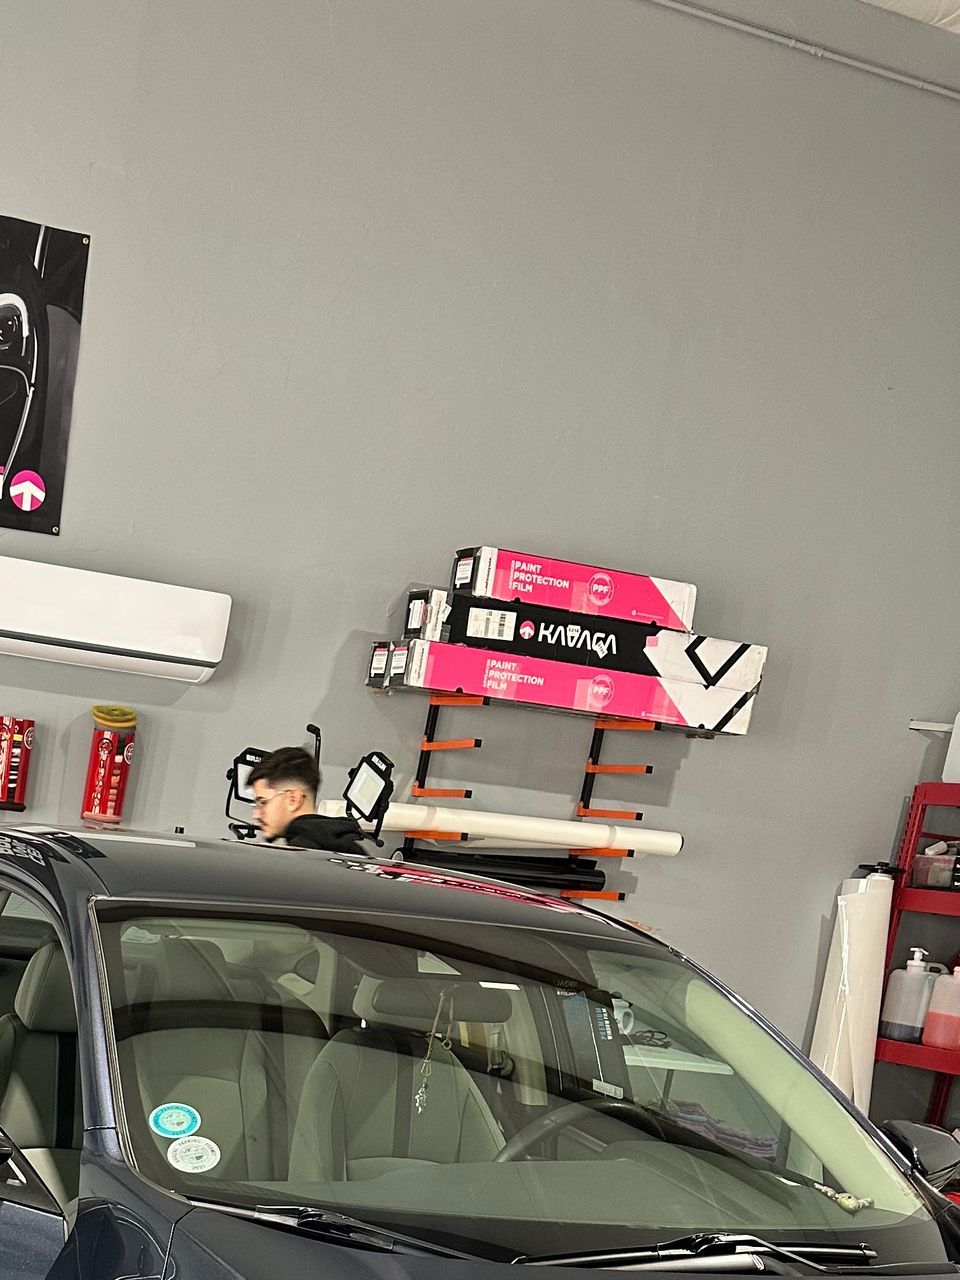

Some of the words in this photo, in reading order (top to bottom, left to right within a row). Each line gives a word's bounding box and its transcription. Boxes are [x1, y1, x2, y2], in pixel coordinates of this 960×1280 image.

[515, 560, 542, 573] PAINT
[513, 571, 570, 589] PROTECTION
[512, 581, 533, 593] FILM
[592, 583, 610, 594] PPF
[490, 659, 518, 671] PAINT
[488, 669, 545, 686] PROTECTION
[486, 680, 508, 691] FILM
[592, 685, 610, 695] PPF
